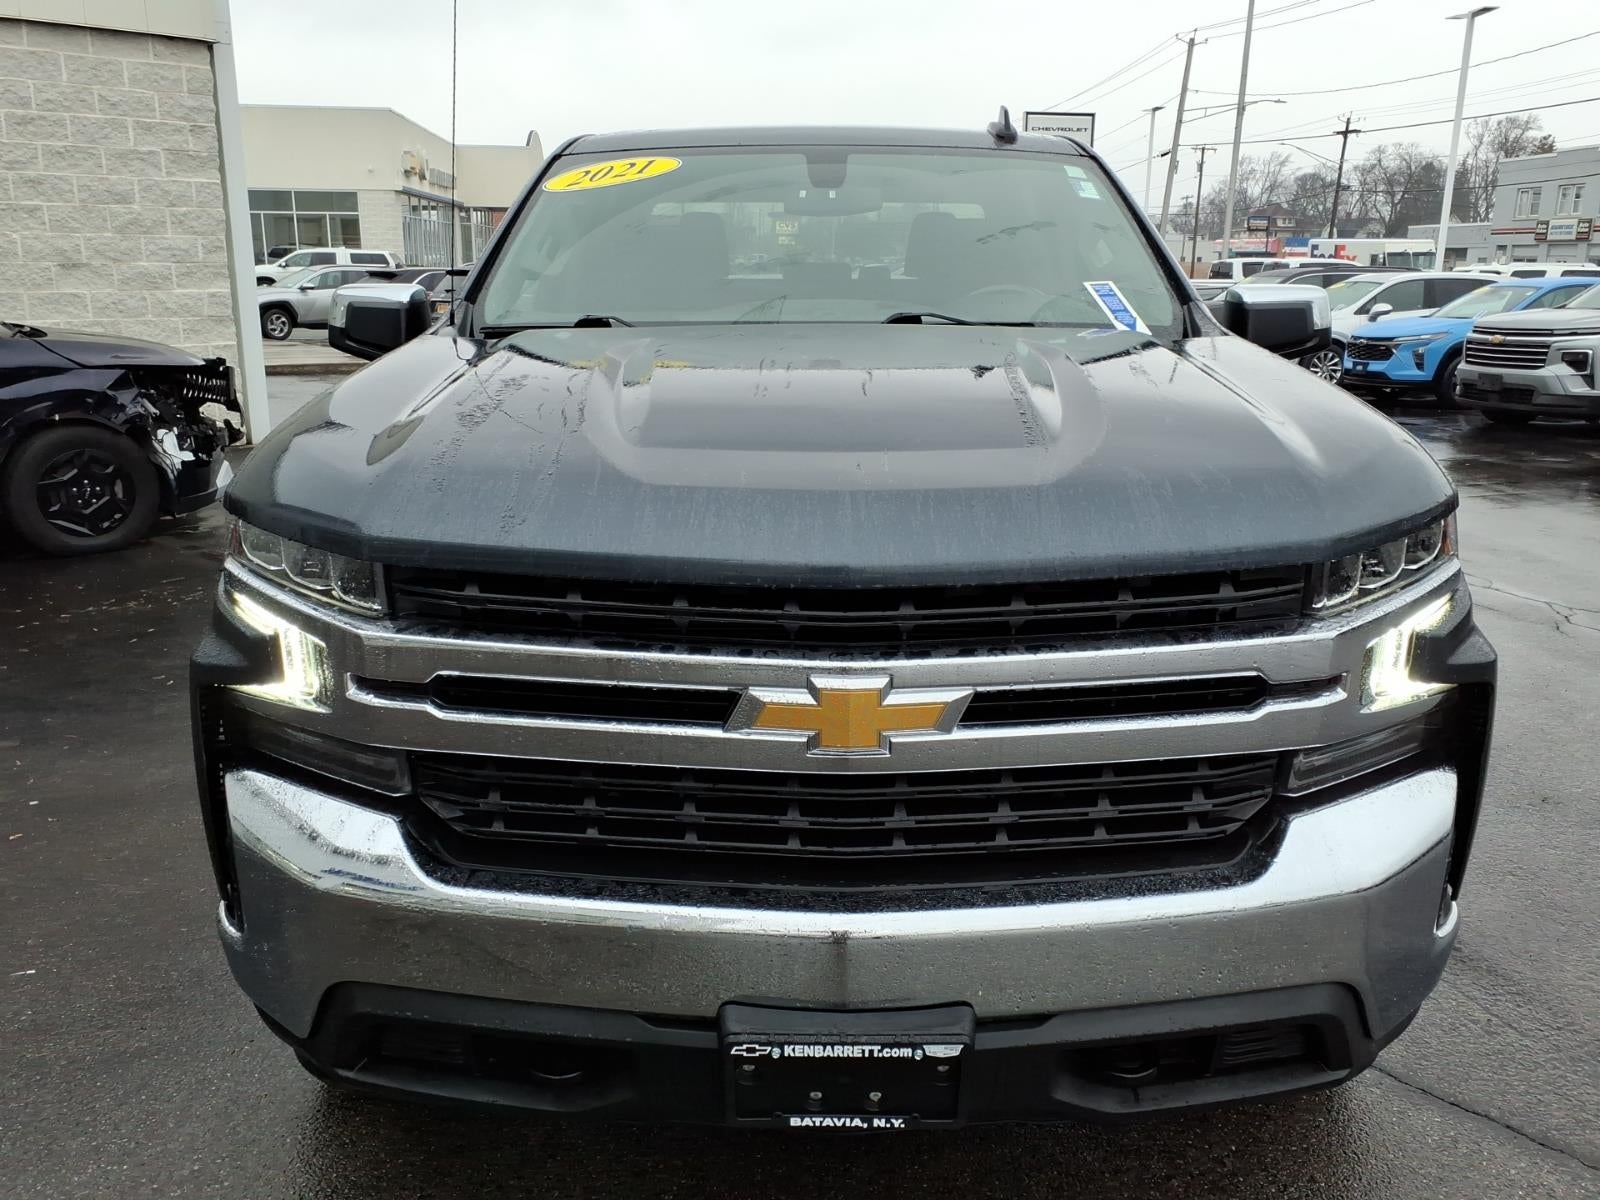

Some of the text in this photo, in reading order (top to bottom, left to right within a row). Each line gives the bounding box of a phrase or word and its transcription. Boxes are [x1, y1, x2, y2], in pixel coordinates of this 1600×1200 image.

[565, 159, 656, 188] 2021
[783, 1044, 913, 1058] KENBARRETT.com
[789, 1117, 905, 1129] BATAVIA, N.Y.
